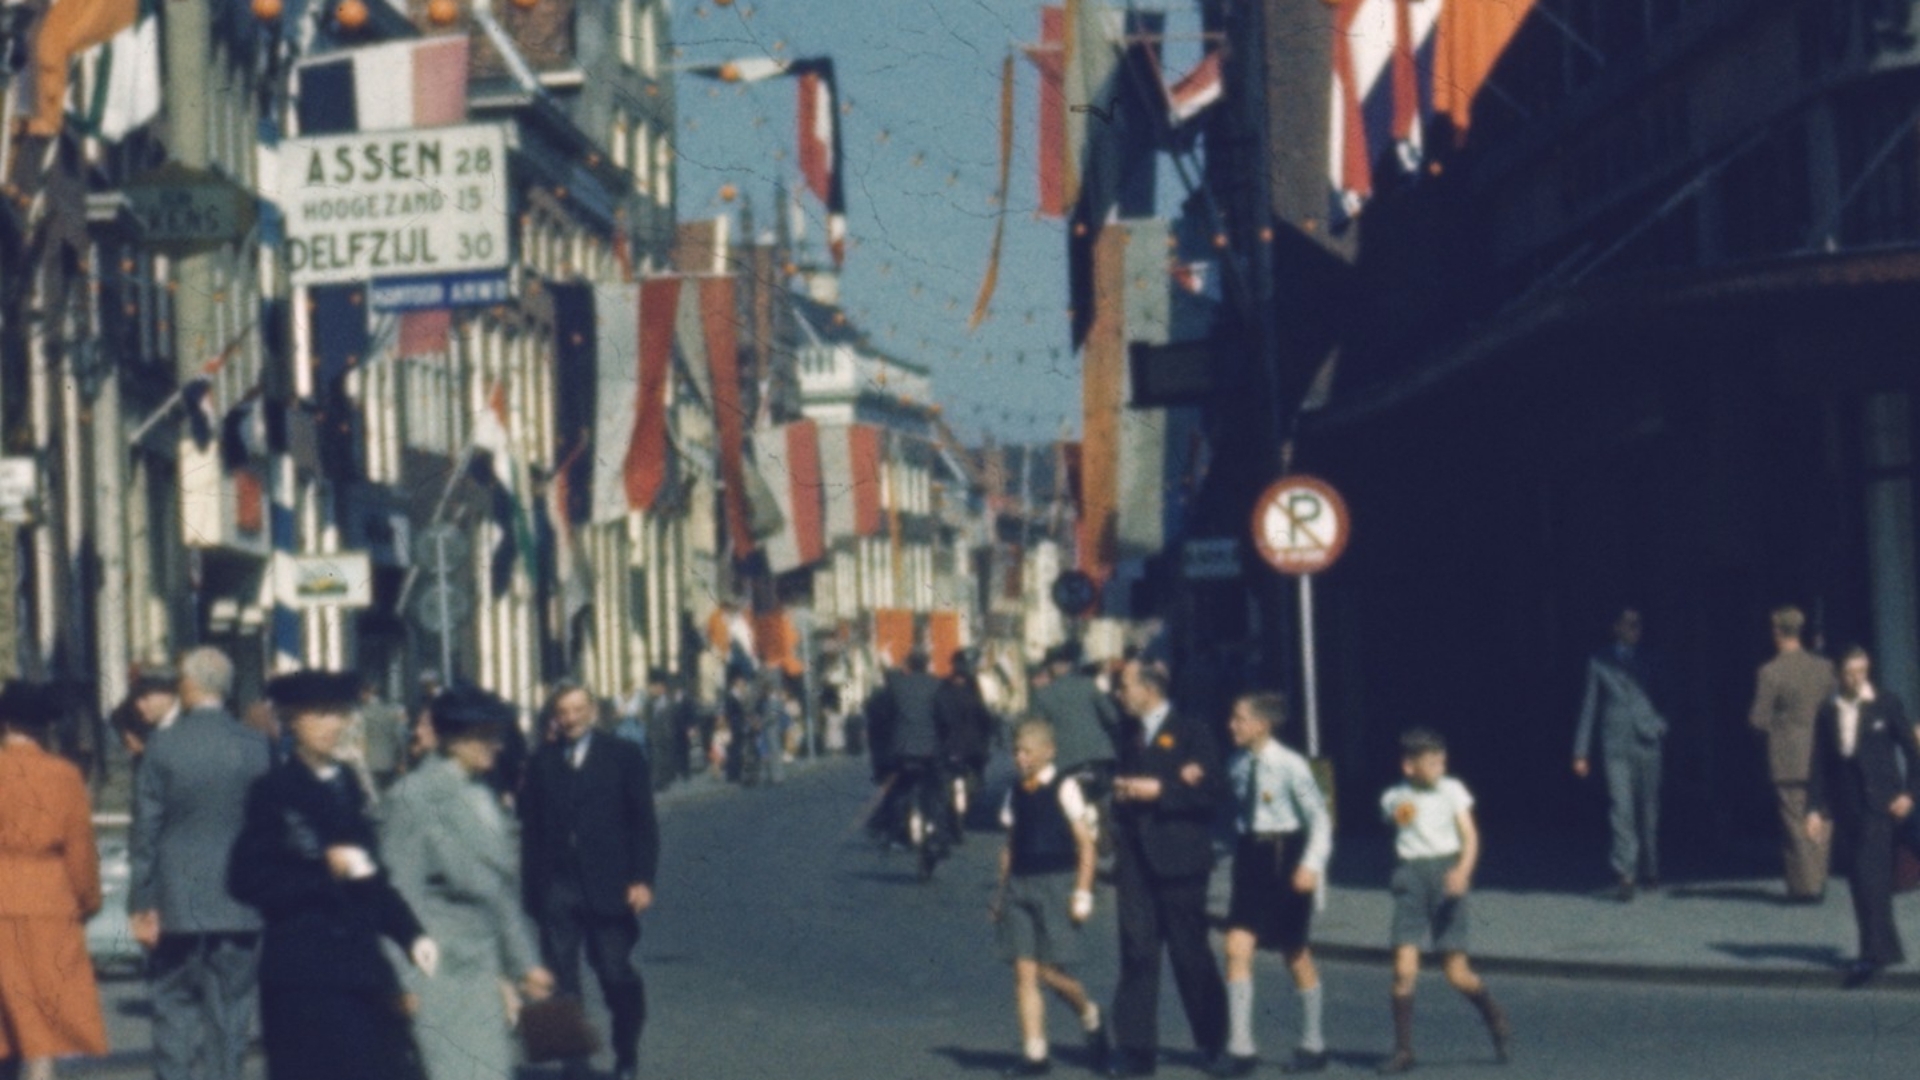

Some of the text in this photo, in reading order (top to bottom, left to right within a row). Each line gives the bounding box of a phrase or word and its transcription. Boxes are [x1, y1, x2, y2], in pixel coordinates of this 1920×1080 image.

[307, 139, 492, 183] ASSEN 28
[303, 185, 482, 220] HOOGEZAND 15
[285, 228, 493, 272] DELFZIJL 30
[1289, 494, 1322, 546] P
